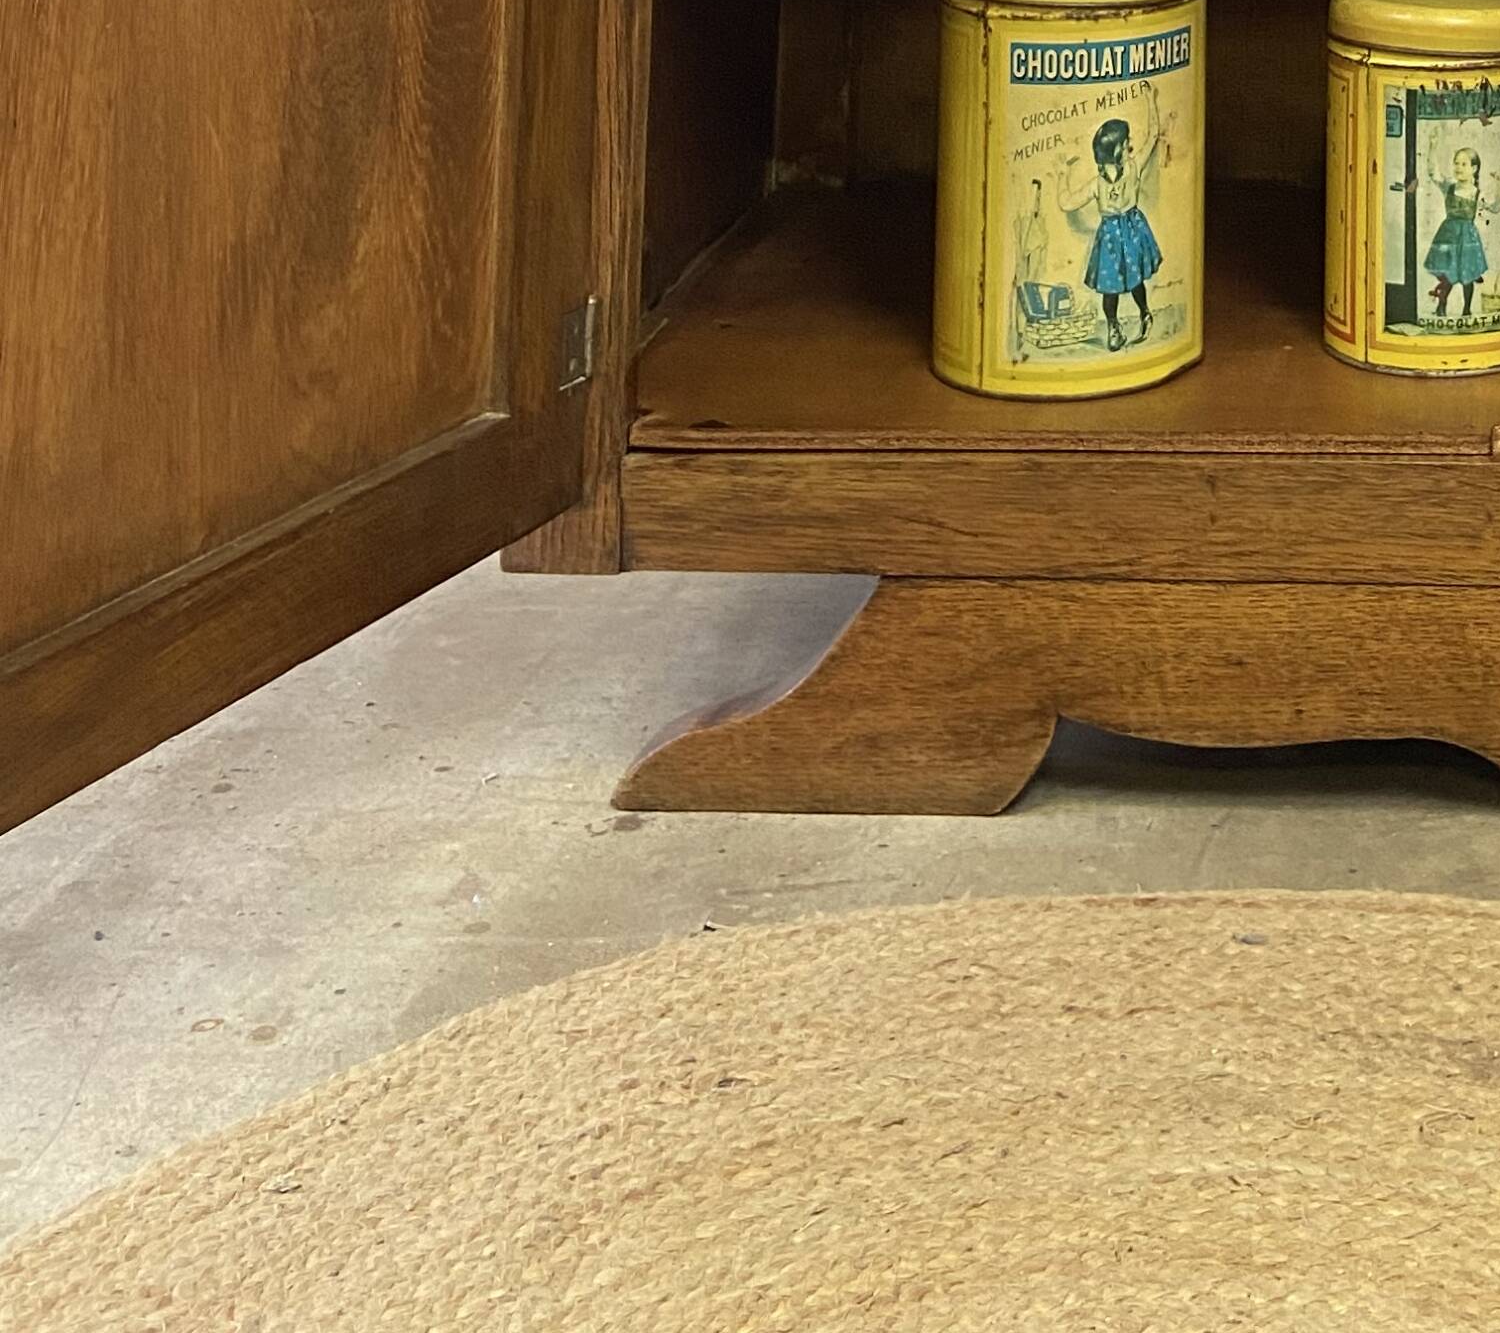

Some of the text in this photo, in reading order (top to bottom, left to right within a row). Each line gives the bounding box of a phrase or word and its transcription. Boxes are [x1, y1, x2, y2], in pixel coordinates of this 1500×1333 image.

[1012, 32, 1191, 80] CHOCOLAT MENIER
[1021, 79, 1152, 131] CHOCOLAT MENIER
[1013, 133, 1066, 162] MENIER
[1418, 316, 1488, 330] CHOCOLAT
